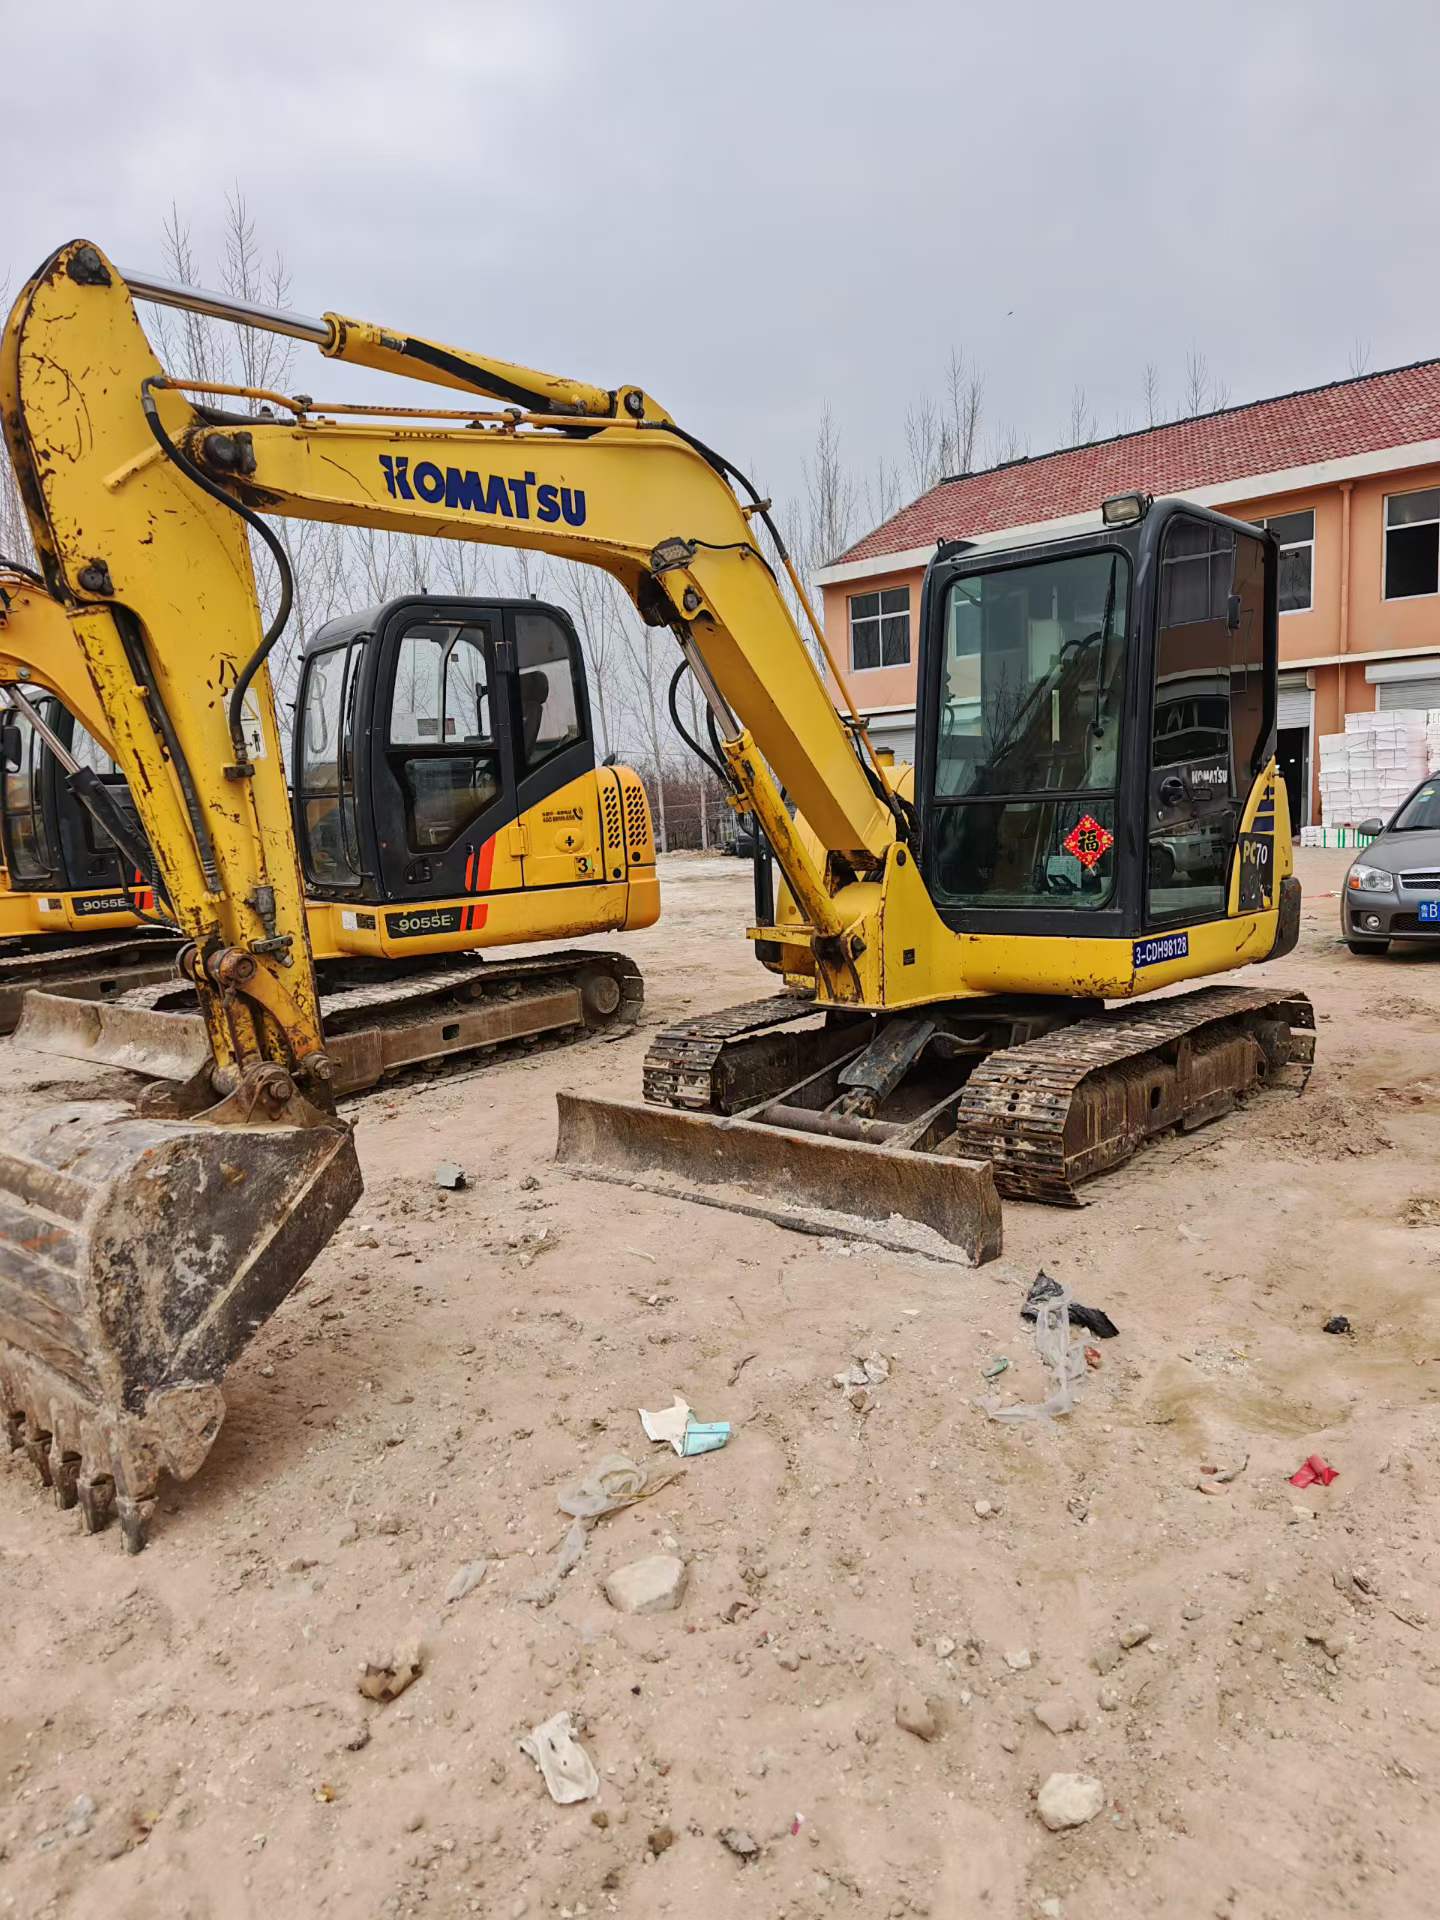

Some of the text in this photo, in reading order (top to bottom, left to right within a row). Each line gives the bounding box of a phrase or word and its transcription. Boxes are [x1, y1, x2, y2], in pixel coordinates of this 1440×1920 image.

[378, 454, 587, 527] KOMATSU
[1191, 765, 1228, 784] KOMATSU
[1077, 829, 1100, 853] 福
[1242, 840, 1268, 869] PC70
[82, 897, 126, 912] 9055E
[398, 913, 452, 932] 9055E
[1135, 936, 1188, 965] 3-CDH98128
